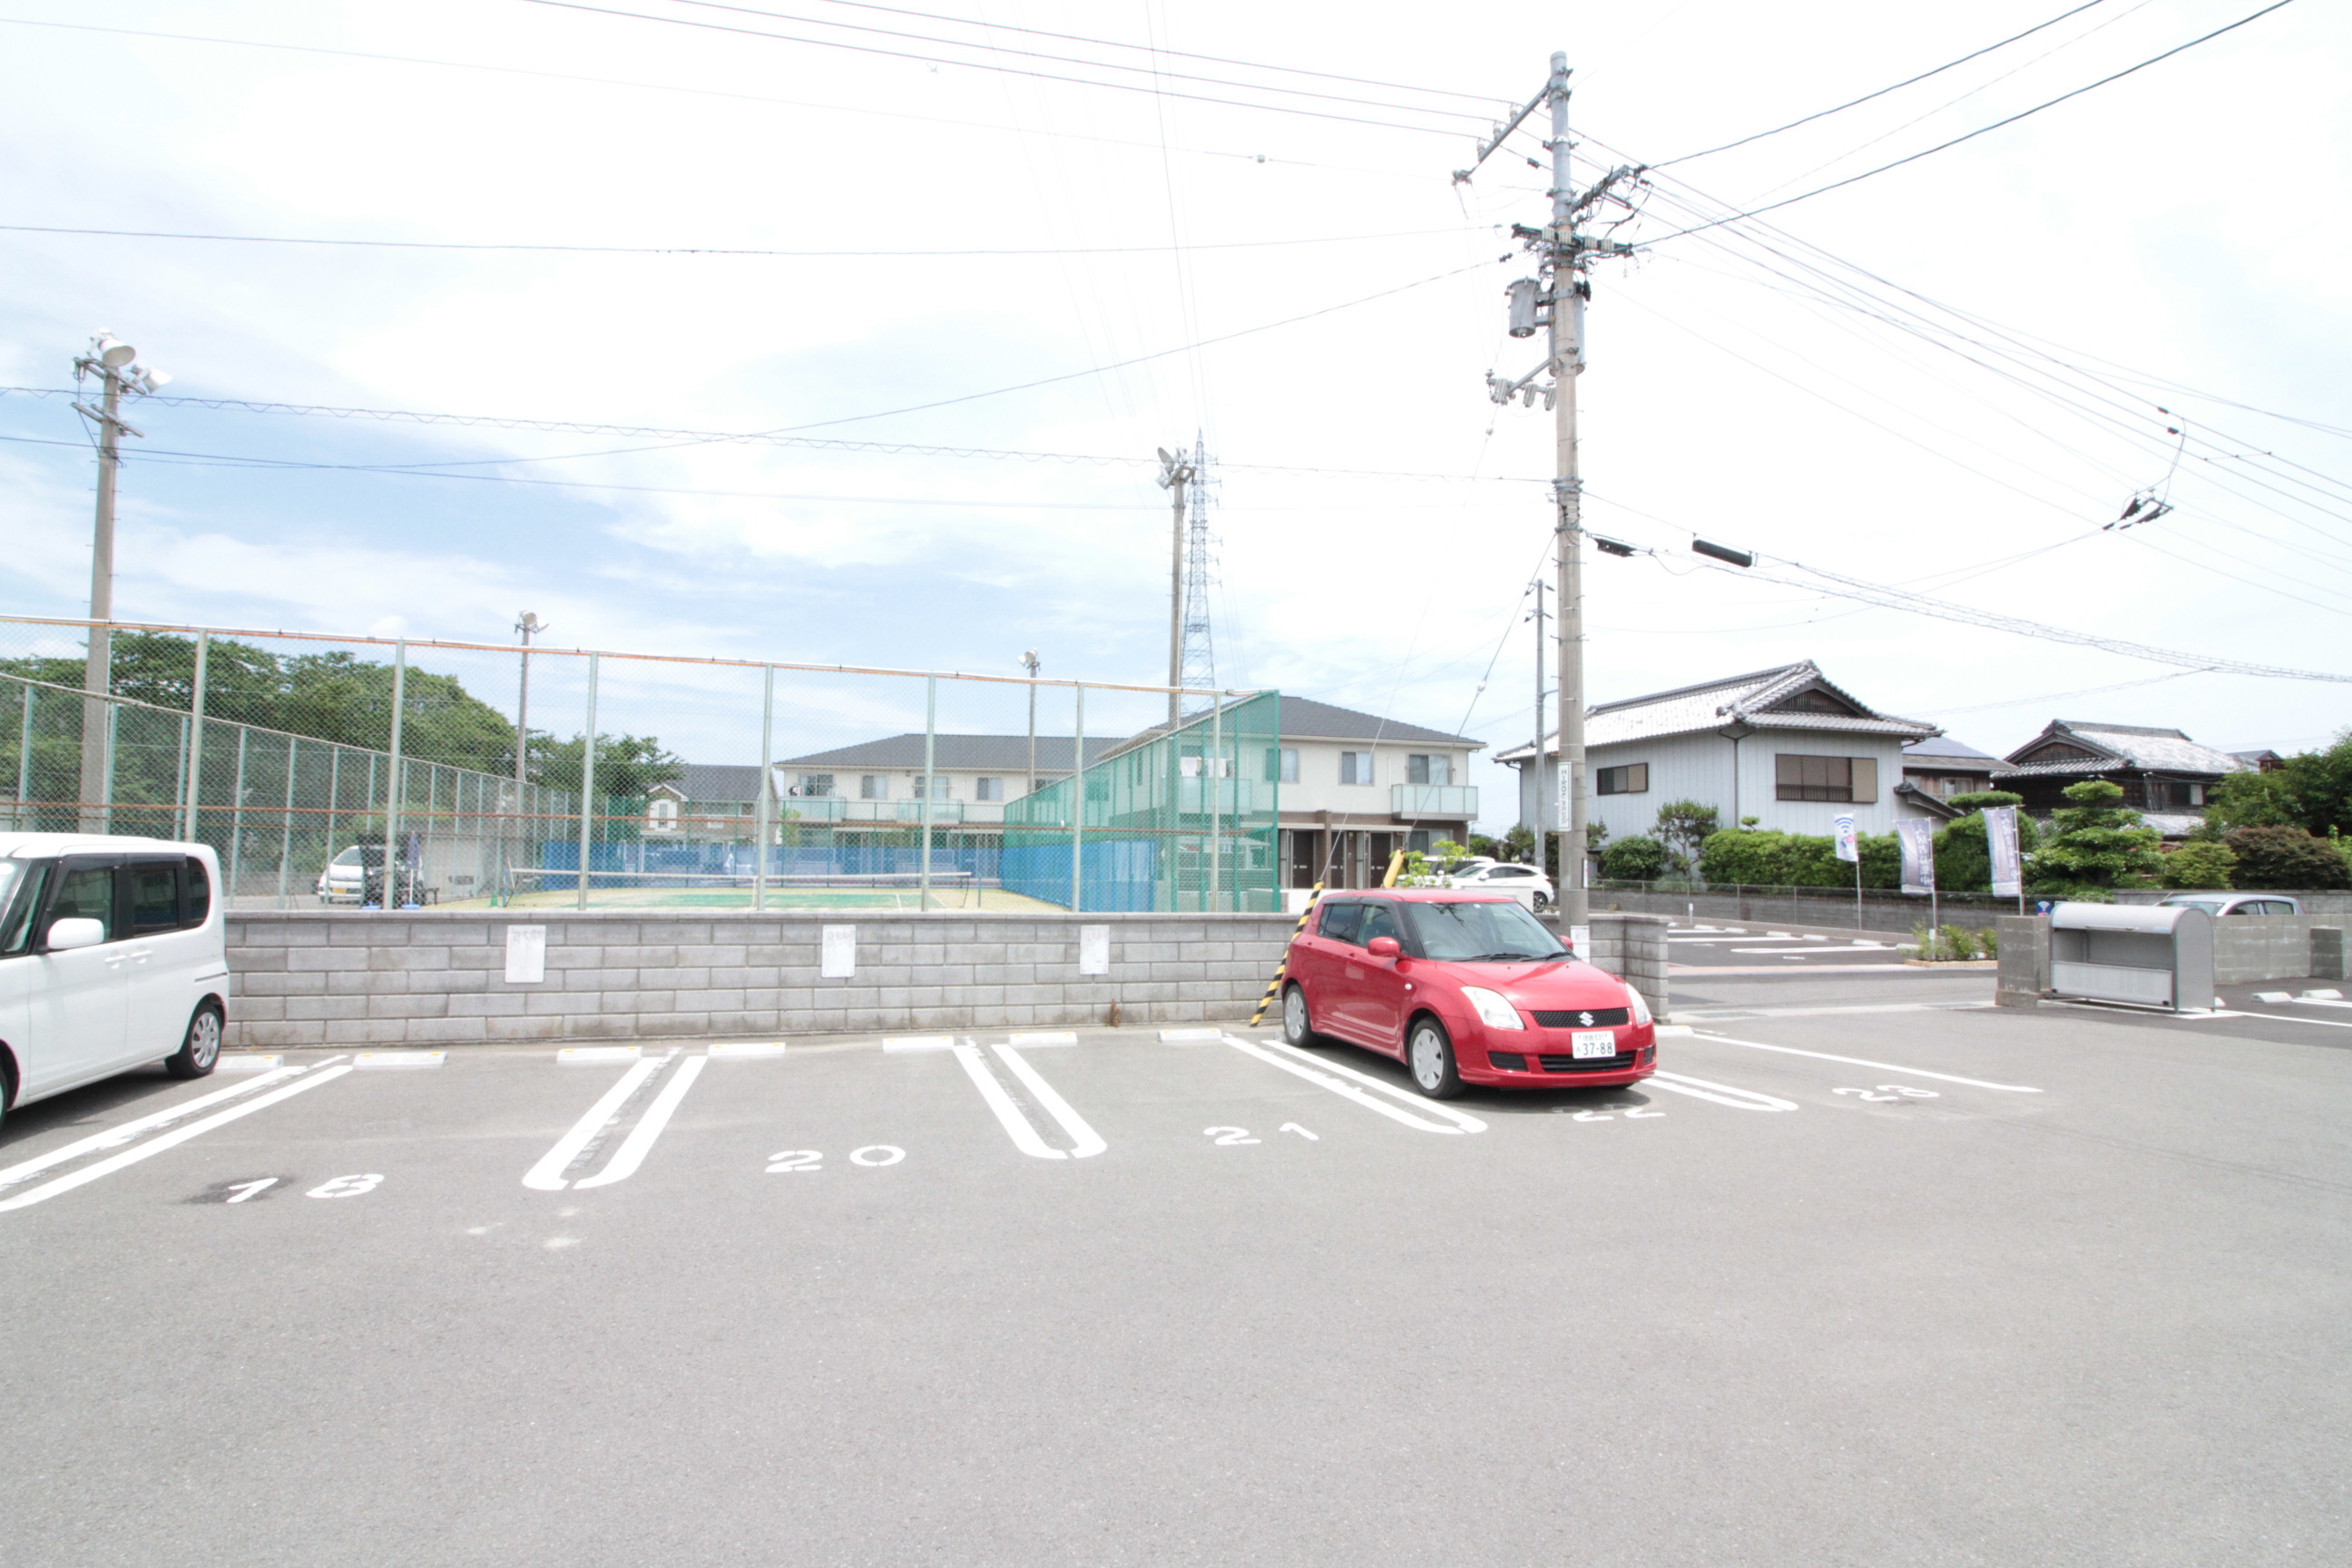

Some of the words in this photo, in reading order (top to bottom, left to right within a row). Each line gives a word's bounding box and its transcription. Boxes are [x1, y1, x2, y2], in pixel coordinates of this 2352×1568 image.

[1583, 1042, 1613, 1055] 37-88
[1203, 1122, 1319, 1145] 21
[765, 1144, 906, 1173] 20
[226, 1173, 386, 1203] 18
